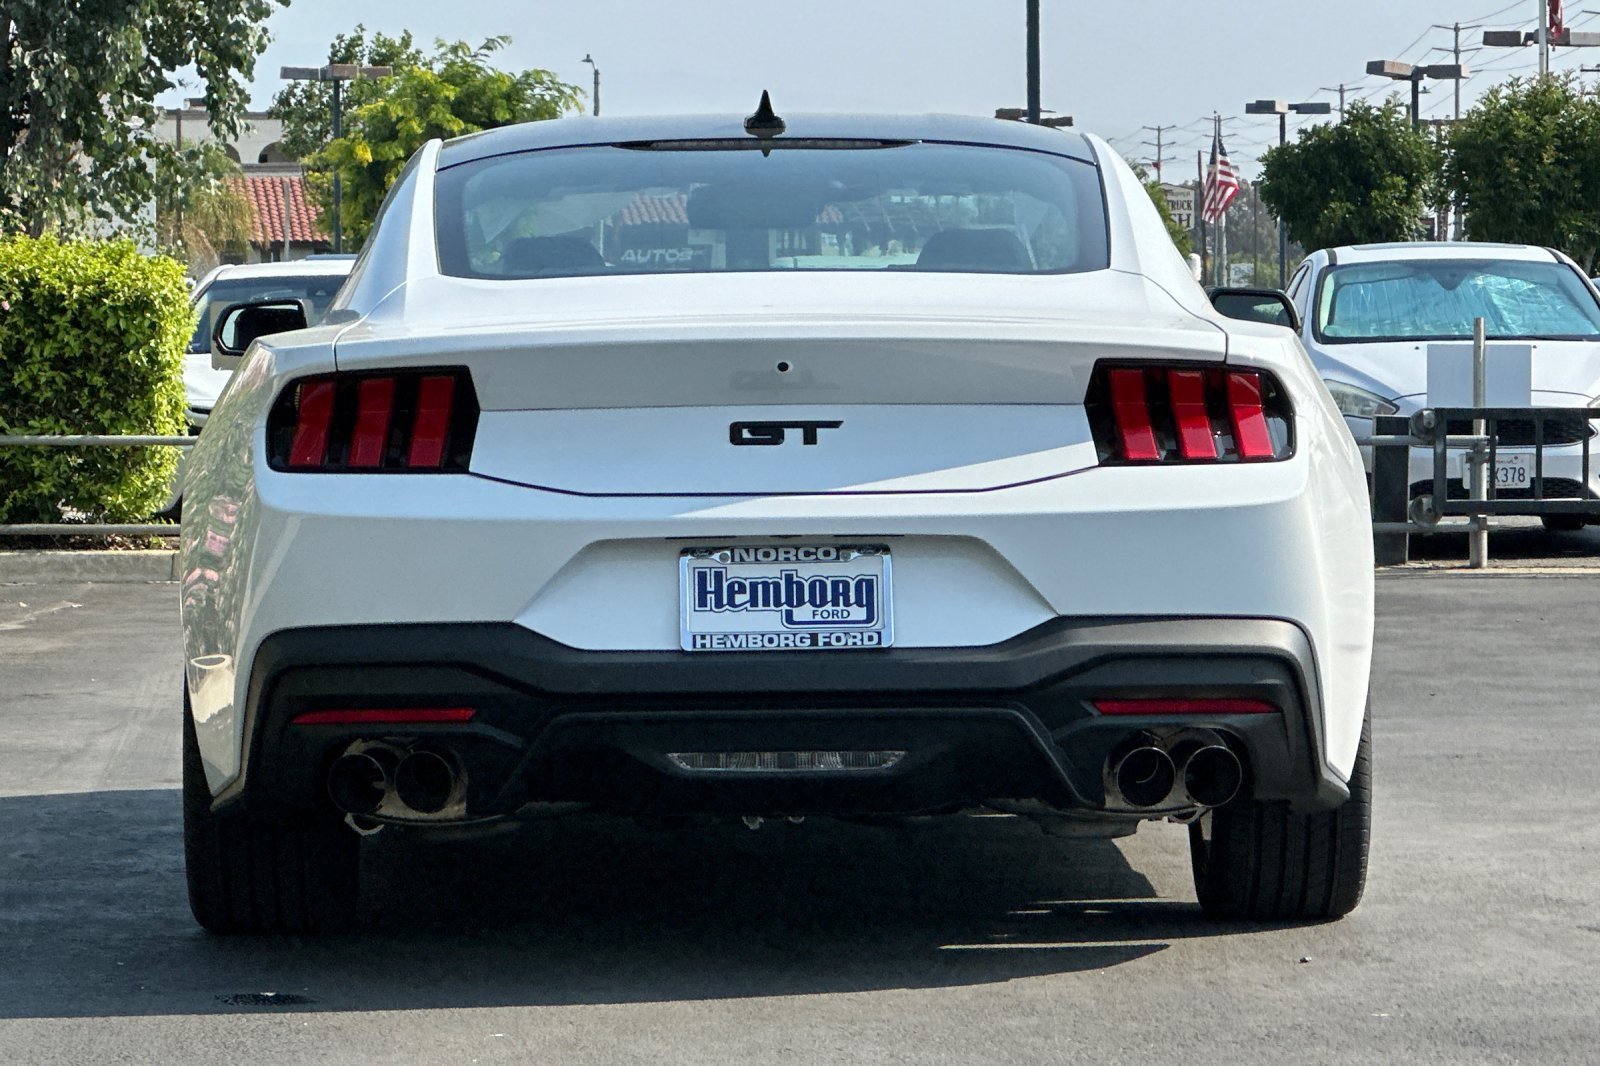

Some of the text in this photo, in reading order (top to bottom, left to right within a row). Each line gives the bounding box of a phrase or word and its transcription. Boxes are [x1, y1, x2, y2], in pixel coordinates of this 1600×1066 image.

[729, 420, 844, 446] GT
[733, 547, 838, 562] NORCO
[812, 609, 851, 620] FORD
[695, 632, 879, 649] HEMBORG FORD
